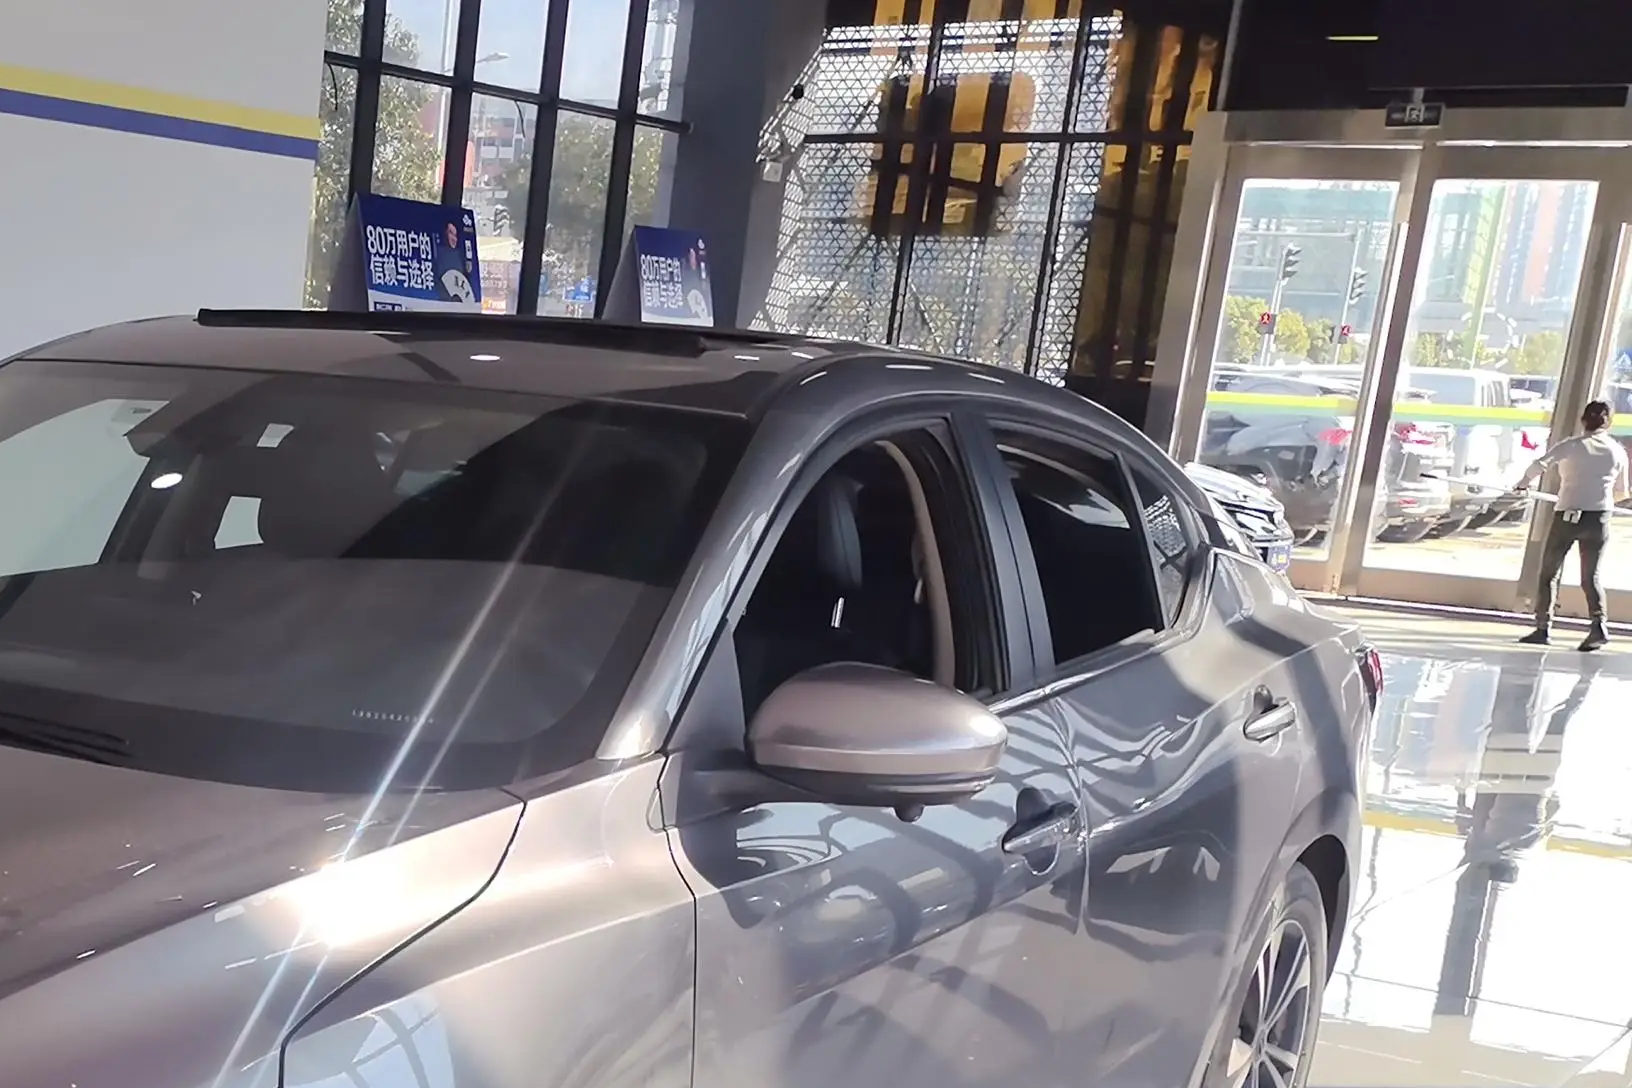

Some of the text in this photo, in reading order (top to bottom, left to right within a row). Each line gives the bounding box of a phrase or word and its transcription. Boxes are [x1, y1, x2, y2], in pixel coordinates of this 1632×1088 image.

[367, 225, 432, 260] 80万用户的
[371, 255, 435, 291] 信赖与选择
